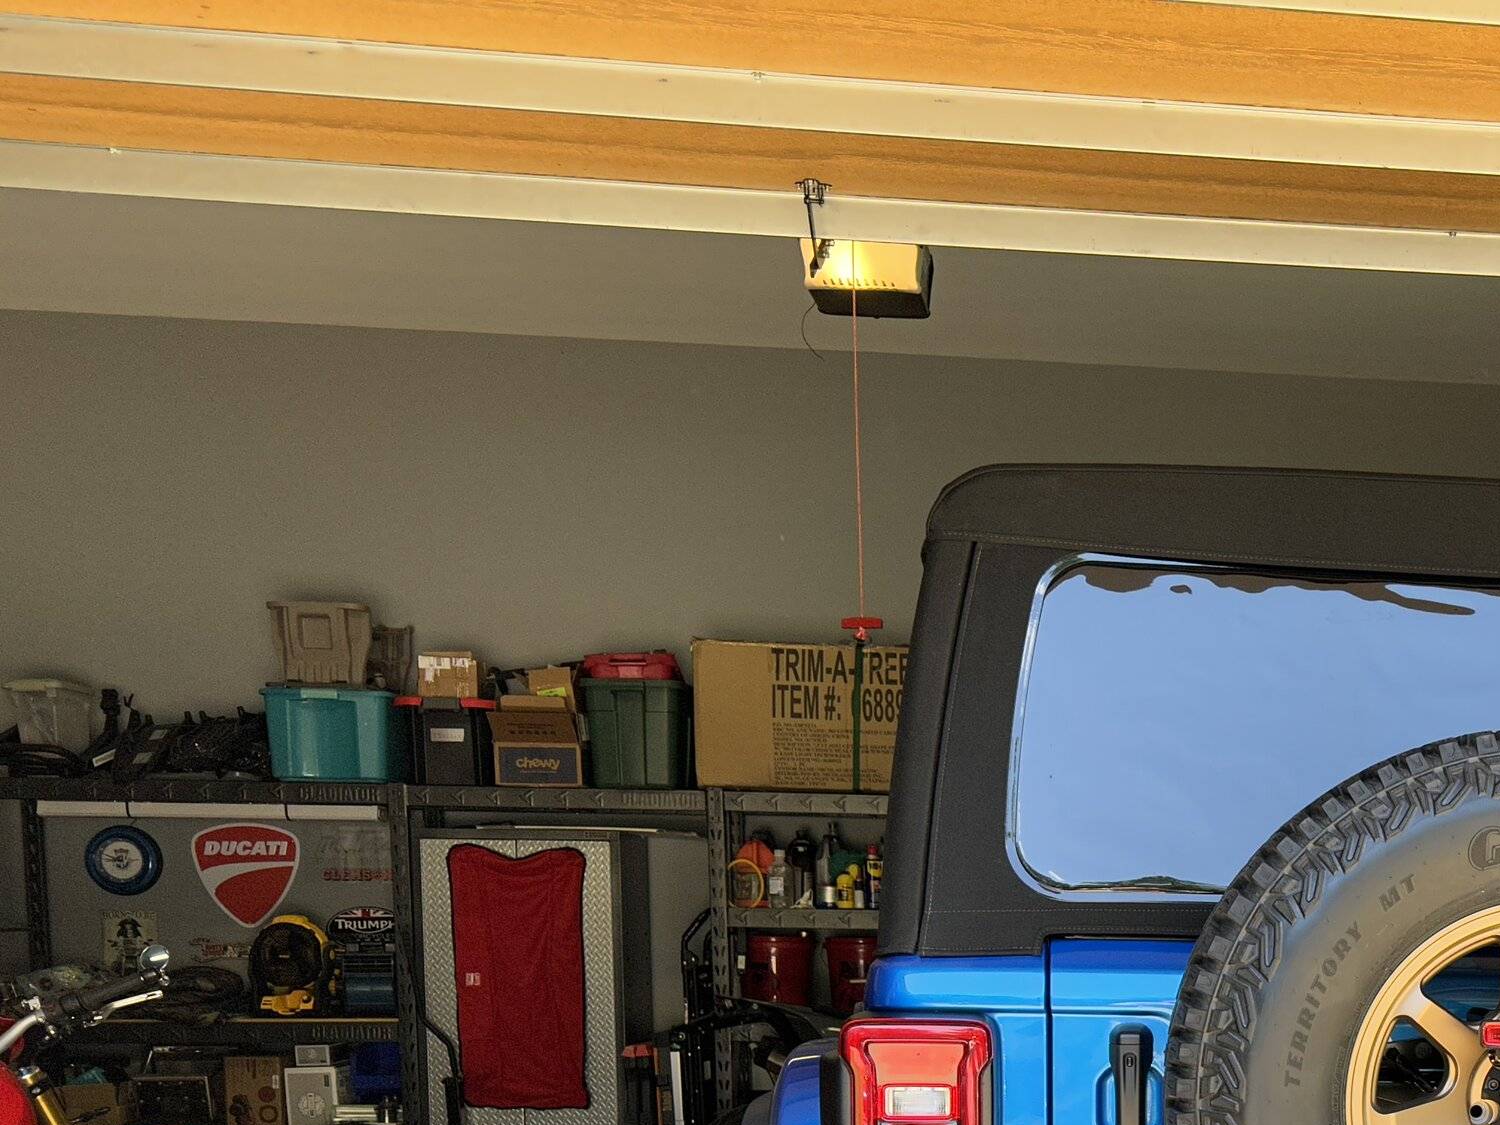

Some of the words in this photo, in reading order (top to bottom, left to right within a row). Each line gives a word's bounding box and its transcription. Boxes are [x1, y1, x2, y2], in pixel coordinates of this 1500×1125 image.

[771, 684, 819, 719] ITEM
[515, 756, 560, 770] chewy
[203, 840, 288, 856] DUCATI
[1284, 920, 1363, 1088] TERRITORY
[1378, 873, 1416, 912] MT
